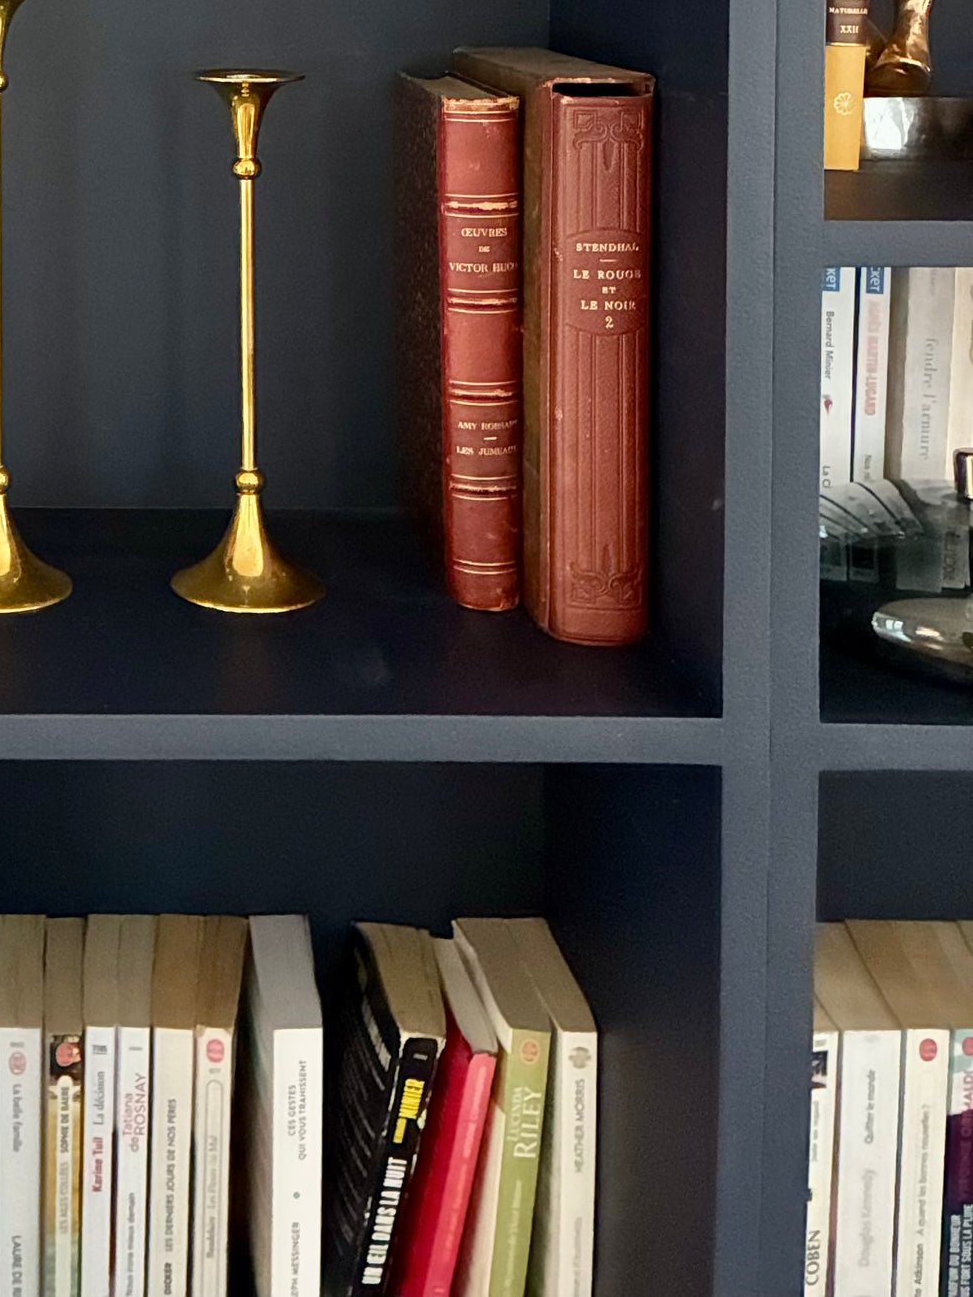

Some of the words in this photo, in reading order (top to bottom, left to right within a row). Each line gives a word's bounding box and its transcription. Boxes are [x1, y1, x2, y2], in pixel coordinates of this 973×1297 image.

[461, 227, 508, 237] ŒUVRES
[478, 245, 490, 253] DE
[575, 242, 640, 252] STENDHAL
[449, 261, 489, 273] VICTOR
[573, 270, 590, 280] LE
[597, 270, 642, 280] ROUGE
[601, 286, 617, 294] ET
[580, 300, 598, 311] LE
[604, 300, 637, 311] NOIR
[605, 316, 614, 329] 2
[826, 311, 835, 347] Bernard
[825, 350, 834, 379] Minier
[457, 421, 477, 430] AMY
[456, 446, 474, 455] LES
[12, 1084, 22, 1095] La
[93, 1071, 105, 1111] décision
[298, 1060, 308, 1114] TRAHISSENT
[865, 1070, 876, 1101] monde
[12, 1097, 23, 1119] belle
[129, 1136, 139, 1152] de
[135, 1072, 146, 1135] ROSNAY
[287, 1084, 296, 1117] GESTES
[575, 1078, 586, 1122] MORRIS
[60, 1113, 70, 1124] DE
[94, 1113, 104, 1125] La
[122, 1093, 133, 1136] Tatiana
[507, 1087, 523, 1141] LUCINDA
[513, 1087, 543, 1159] RILEY
[60, 1126, 70, 1153] SOPHIE
[166, 1126, 176, 1147] NOS
[287, 1119, 296, 1136] CES
[298, 1116, 307, 1141] VOUS
[92, 1136, 103, 1156] Tuil
[166, 1148, 175, 1161] DE
[298, 1143, 307, 1160] QUI
[574, 1124, 584, 1173] HEATHER
[92, 1159, 103, 1192] Karine
[165, 1163, 175, 1192] JOURS
[382, 1157, 408, 1188] NUIT
[125, 1192, 136, 1223] demain
[379, 1190, 401, 1205] LA
[165, 1194, 175, 1235] DERNIERS
[371, 1207, 397, 1241] DANS
[12, 1235, 22, 1270] LAURE
[165, 1237, 174, 1252] LES
[290, 1222, 300, 1275] MESSINGER
[962, 1240, 972, 1263] SOUS
[804, 1230, 821, 1286] COBEN
[12, 1271, 22, 1285] DE
